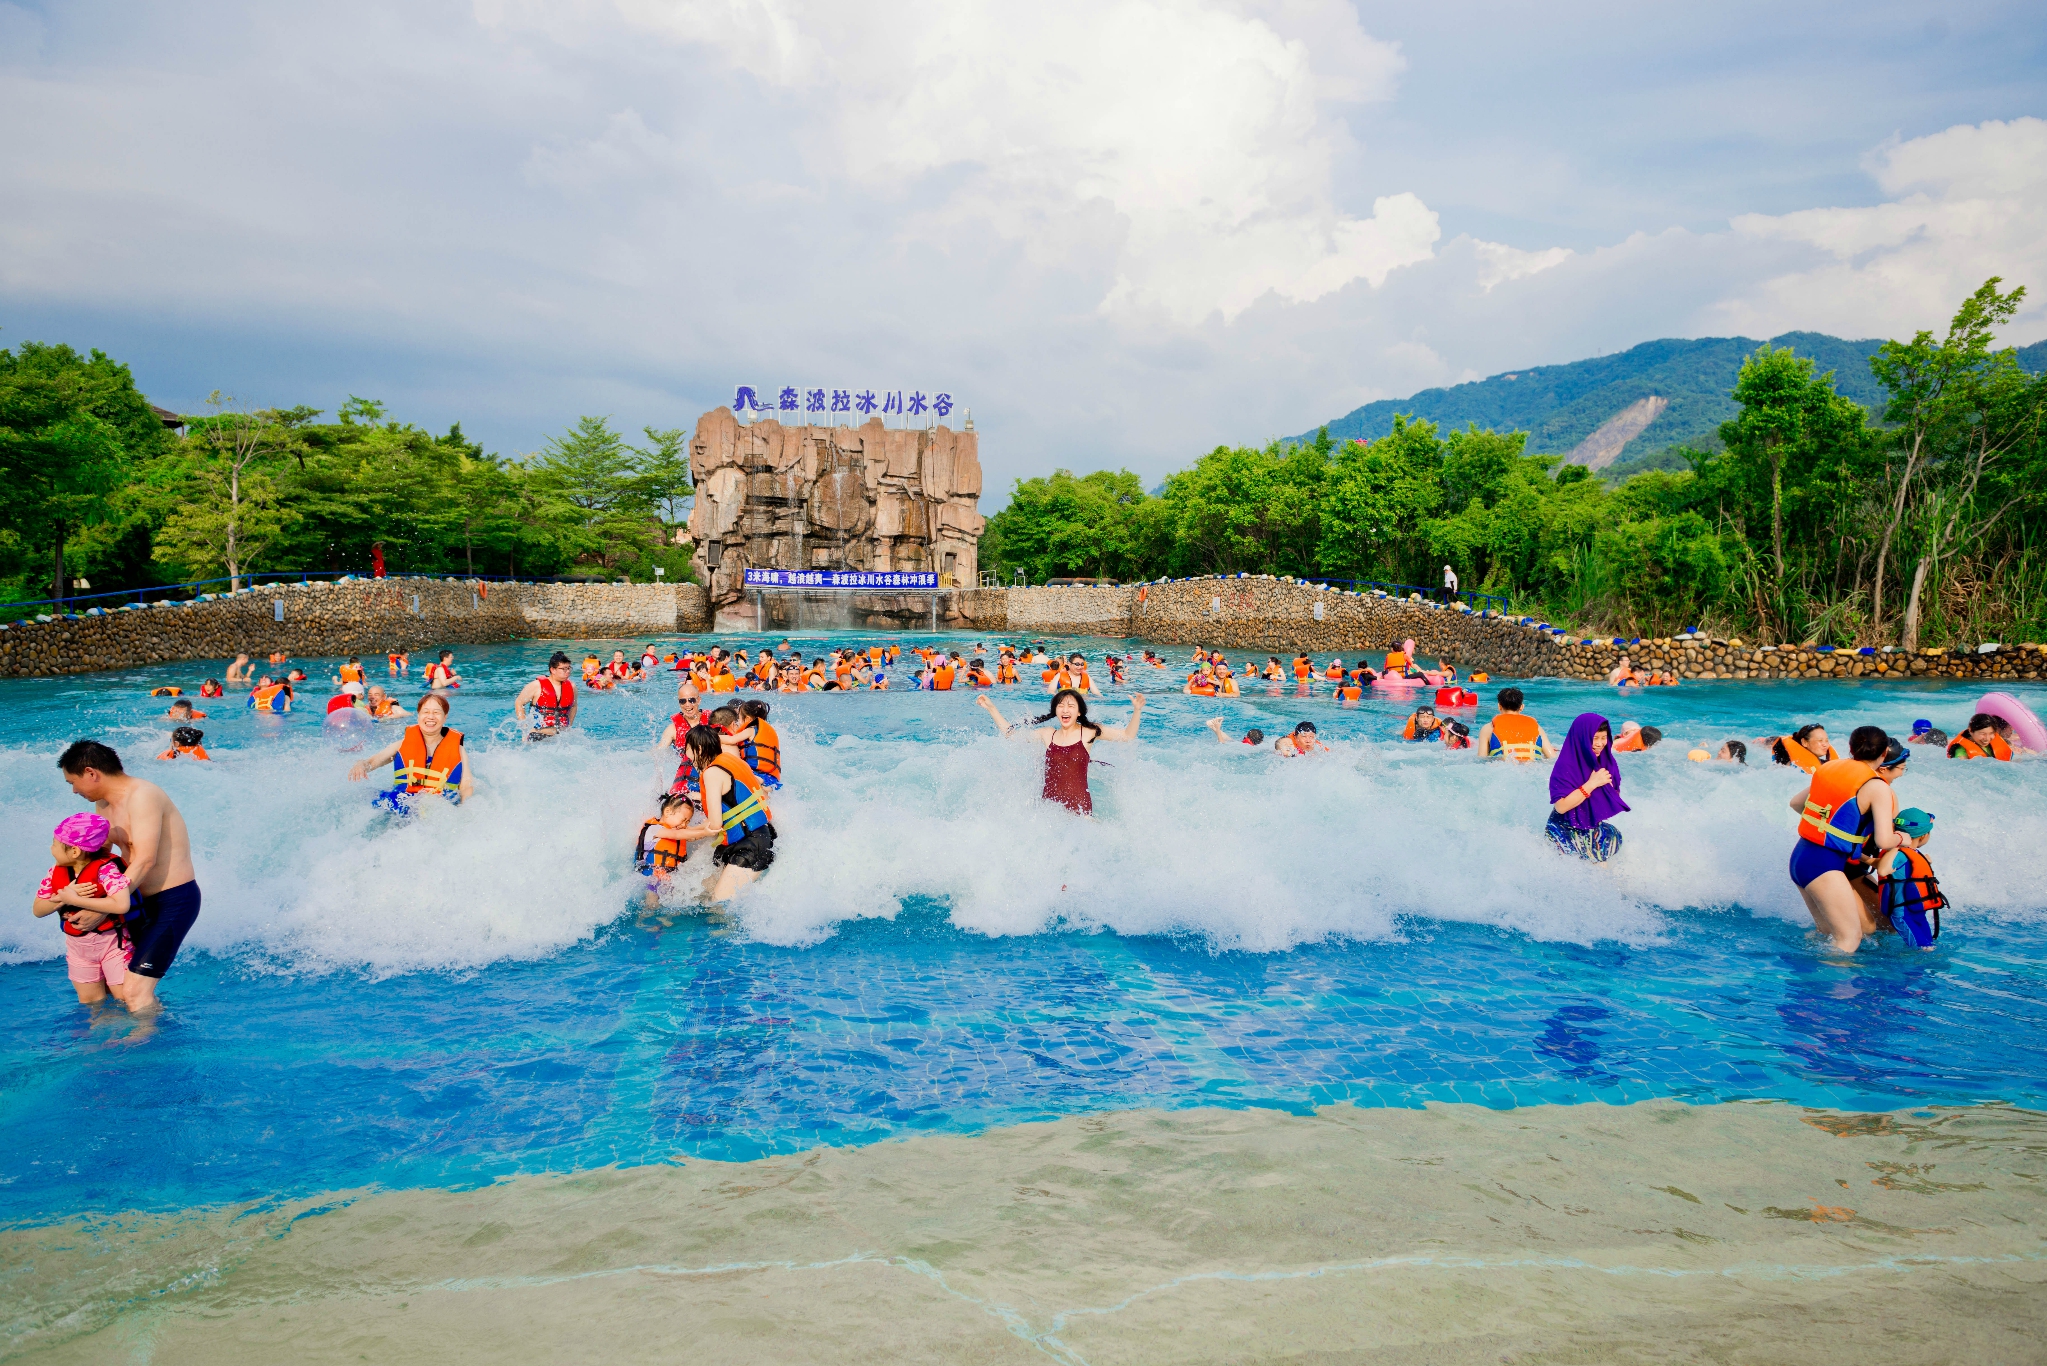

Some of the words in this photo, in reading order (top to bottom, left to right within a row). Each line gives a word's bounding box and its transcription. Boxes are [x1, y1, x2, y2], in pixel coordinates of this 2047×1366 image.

[779, 386, 953, 416] 森波拉冰川水谷
